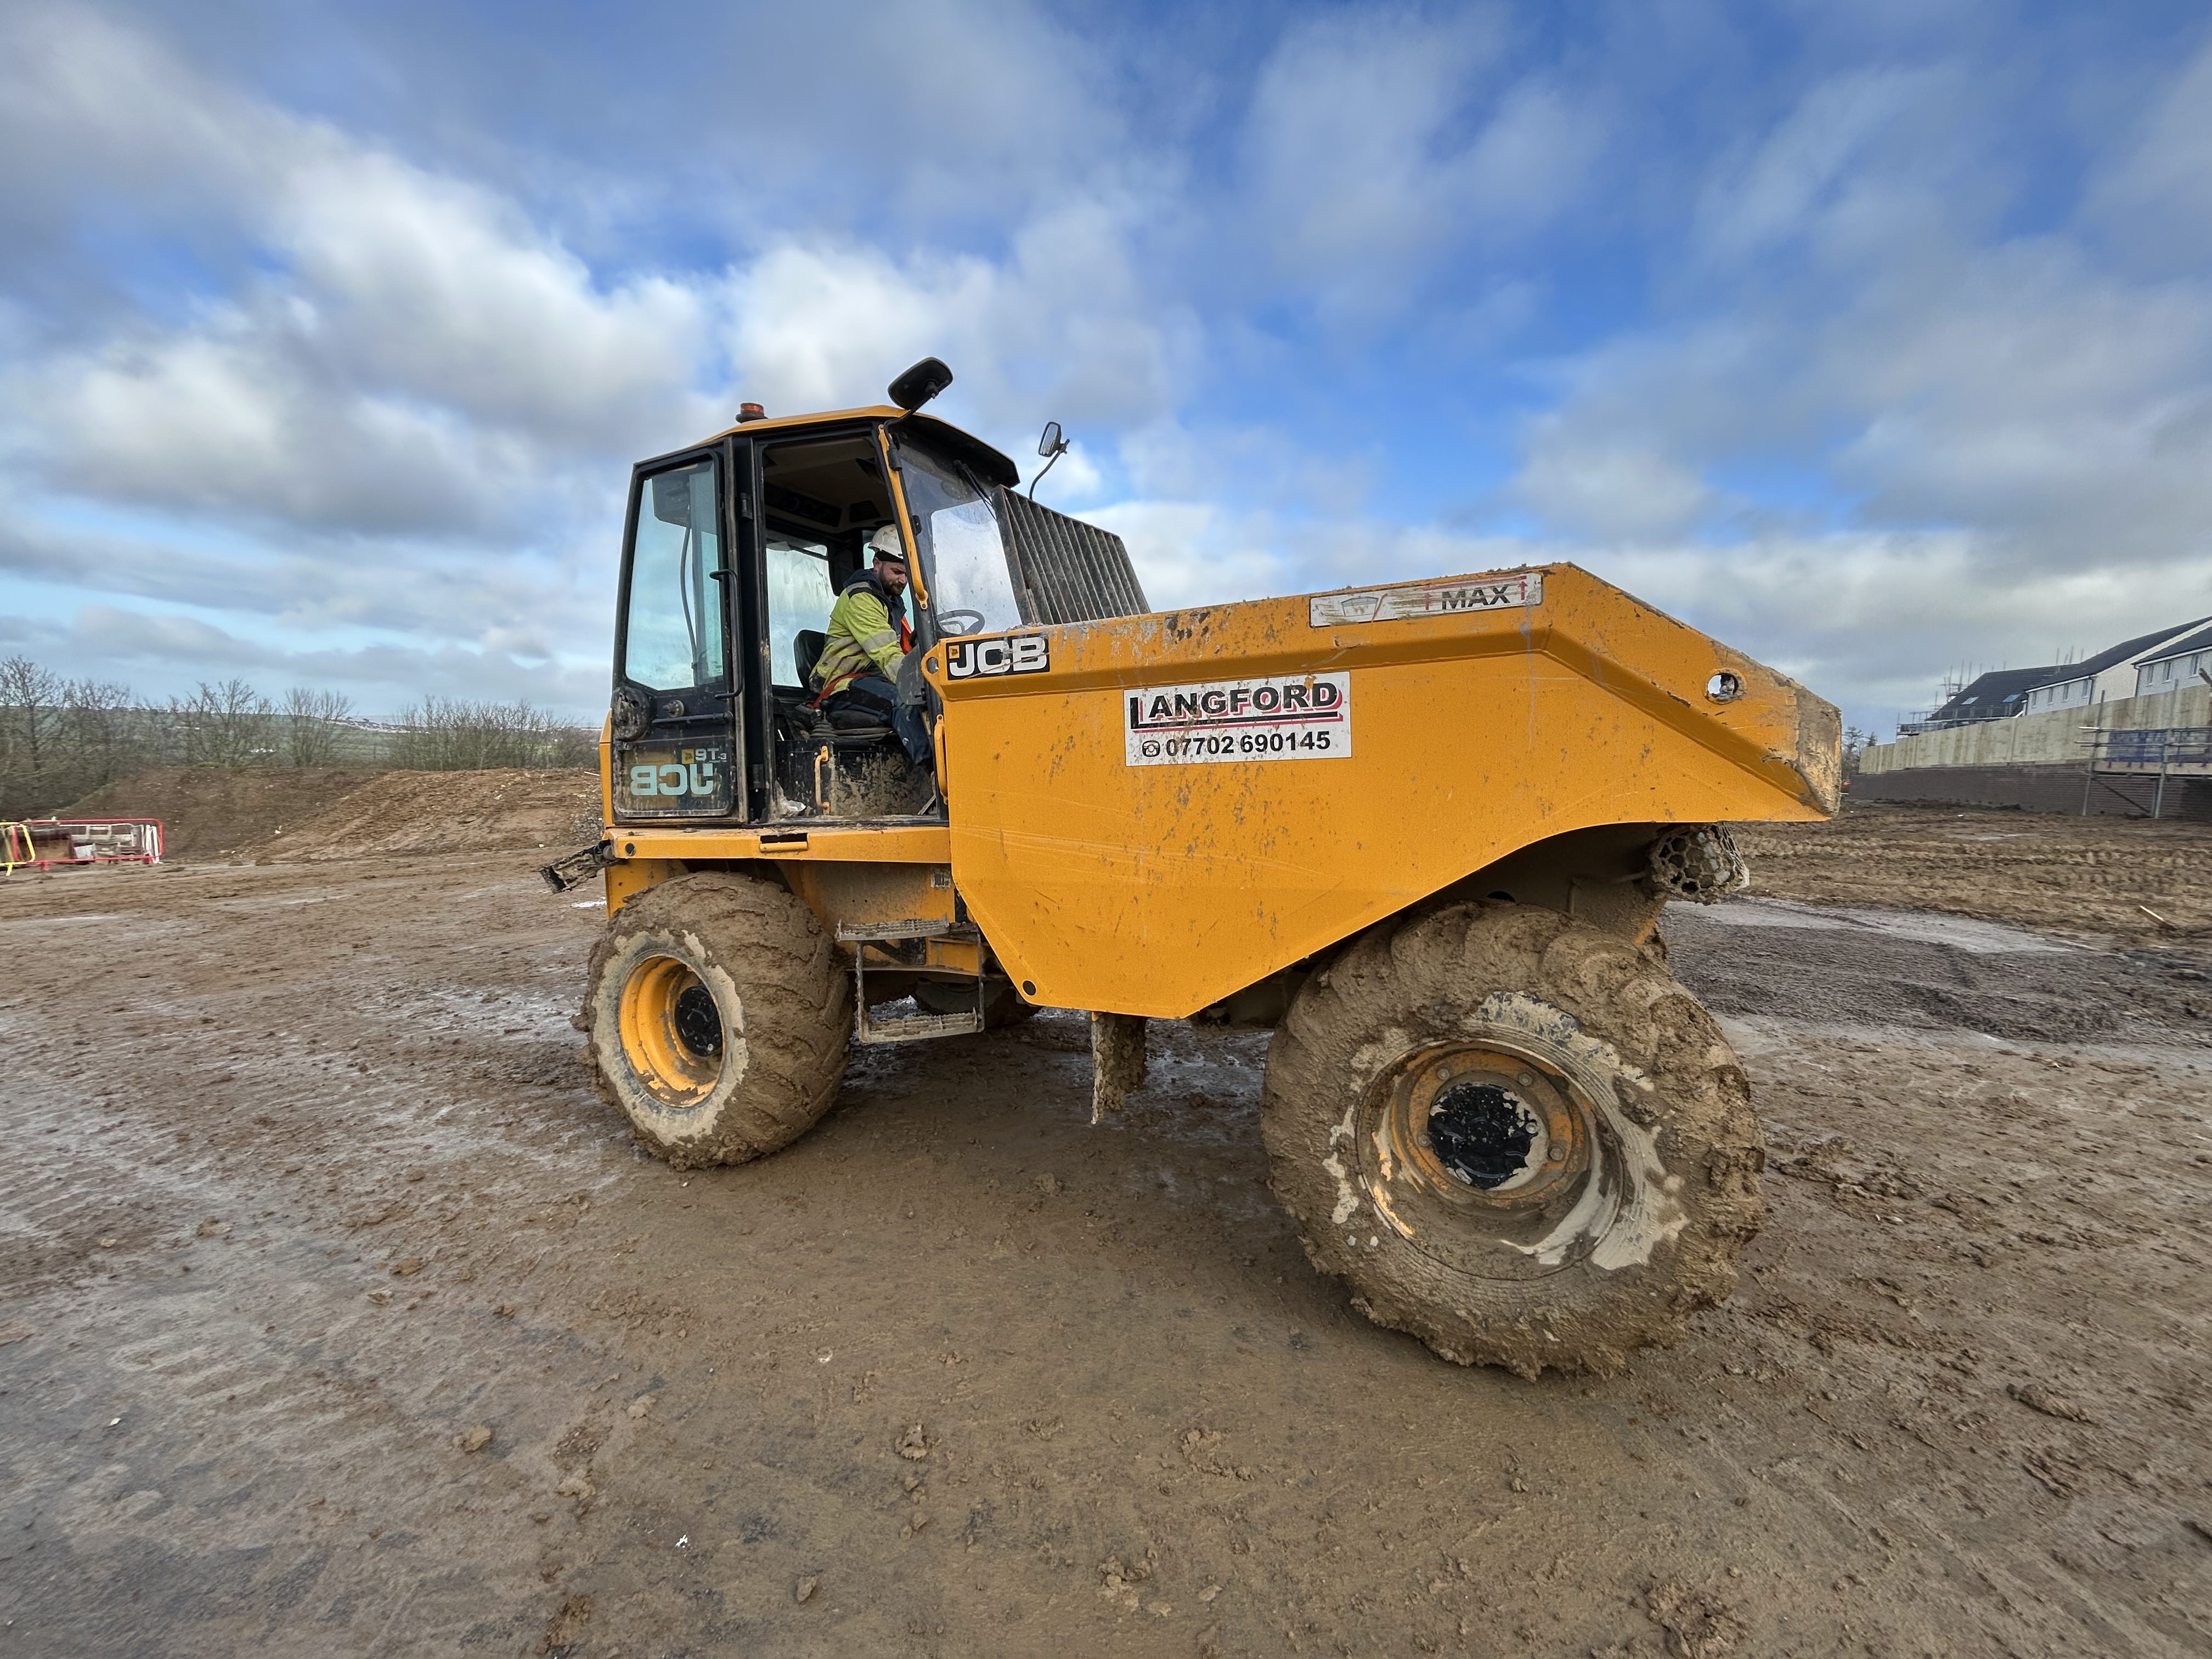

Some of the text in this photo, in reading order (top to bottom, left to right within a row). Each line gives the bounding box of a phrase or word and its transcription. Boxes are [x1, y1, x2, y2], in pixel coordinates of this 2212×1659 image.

[1442, 585, 1510, 610] MAX
[949, 636, 1047, 676] JCB
[1130, 682, 1339, 730] LANGFORD
[1166, 730, 1330, 756] 07702 690145
